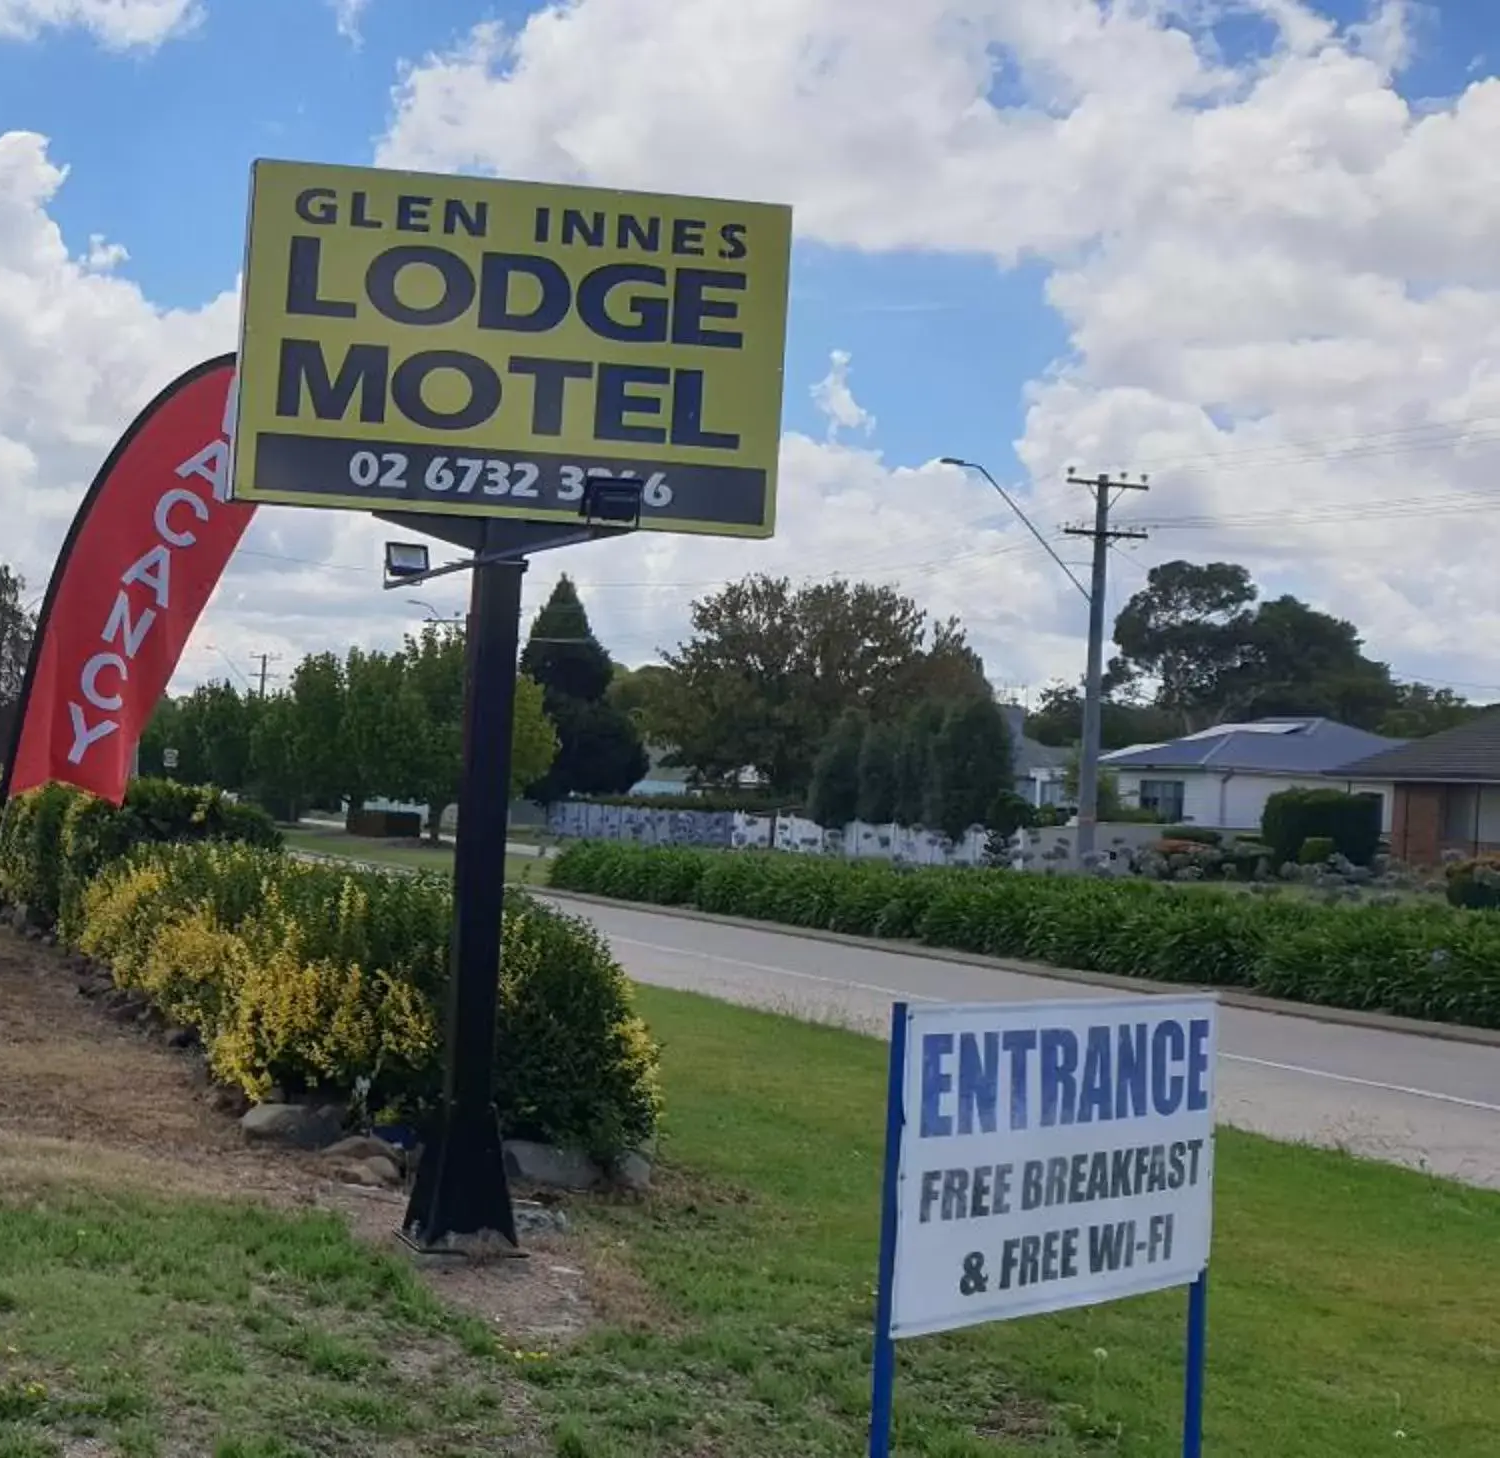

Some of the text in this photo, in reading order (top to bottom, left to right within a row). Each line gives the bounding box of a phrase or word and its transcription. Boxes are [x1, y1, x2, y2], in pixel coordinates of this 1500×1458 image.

[295, 188, 748, 258] GLEN INNES
[286, 236, 748, 349] LODGE
[275, 338, 741, 450] MOTEL
[349, 451, 408, 489] 02
[424, 456, 539, 497] 6732
[919, 1019, 1209, 1139] ENTRANCE
[919, 1139, 1204, 1224] FREE BREAKFAST
[959, 1213, 1174, 1297] & FREE WI-FI
